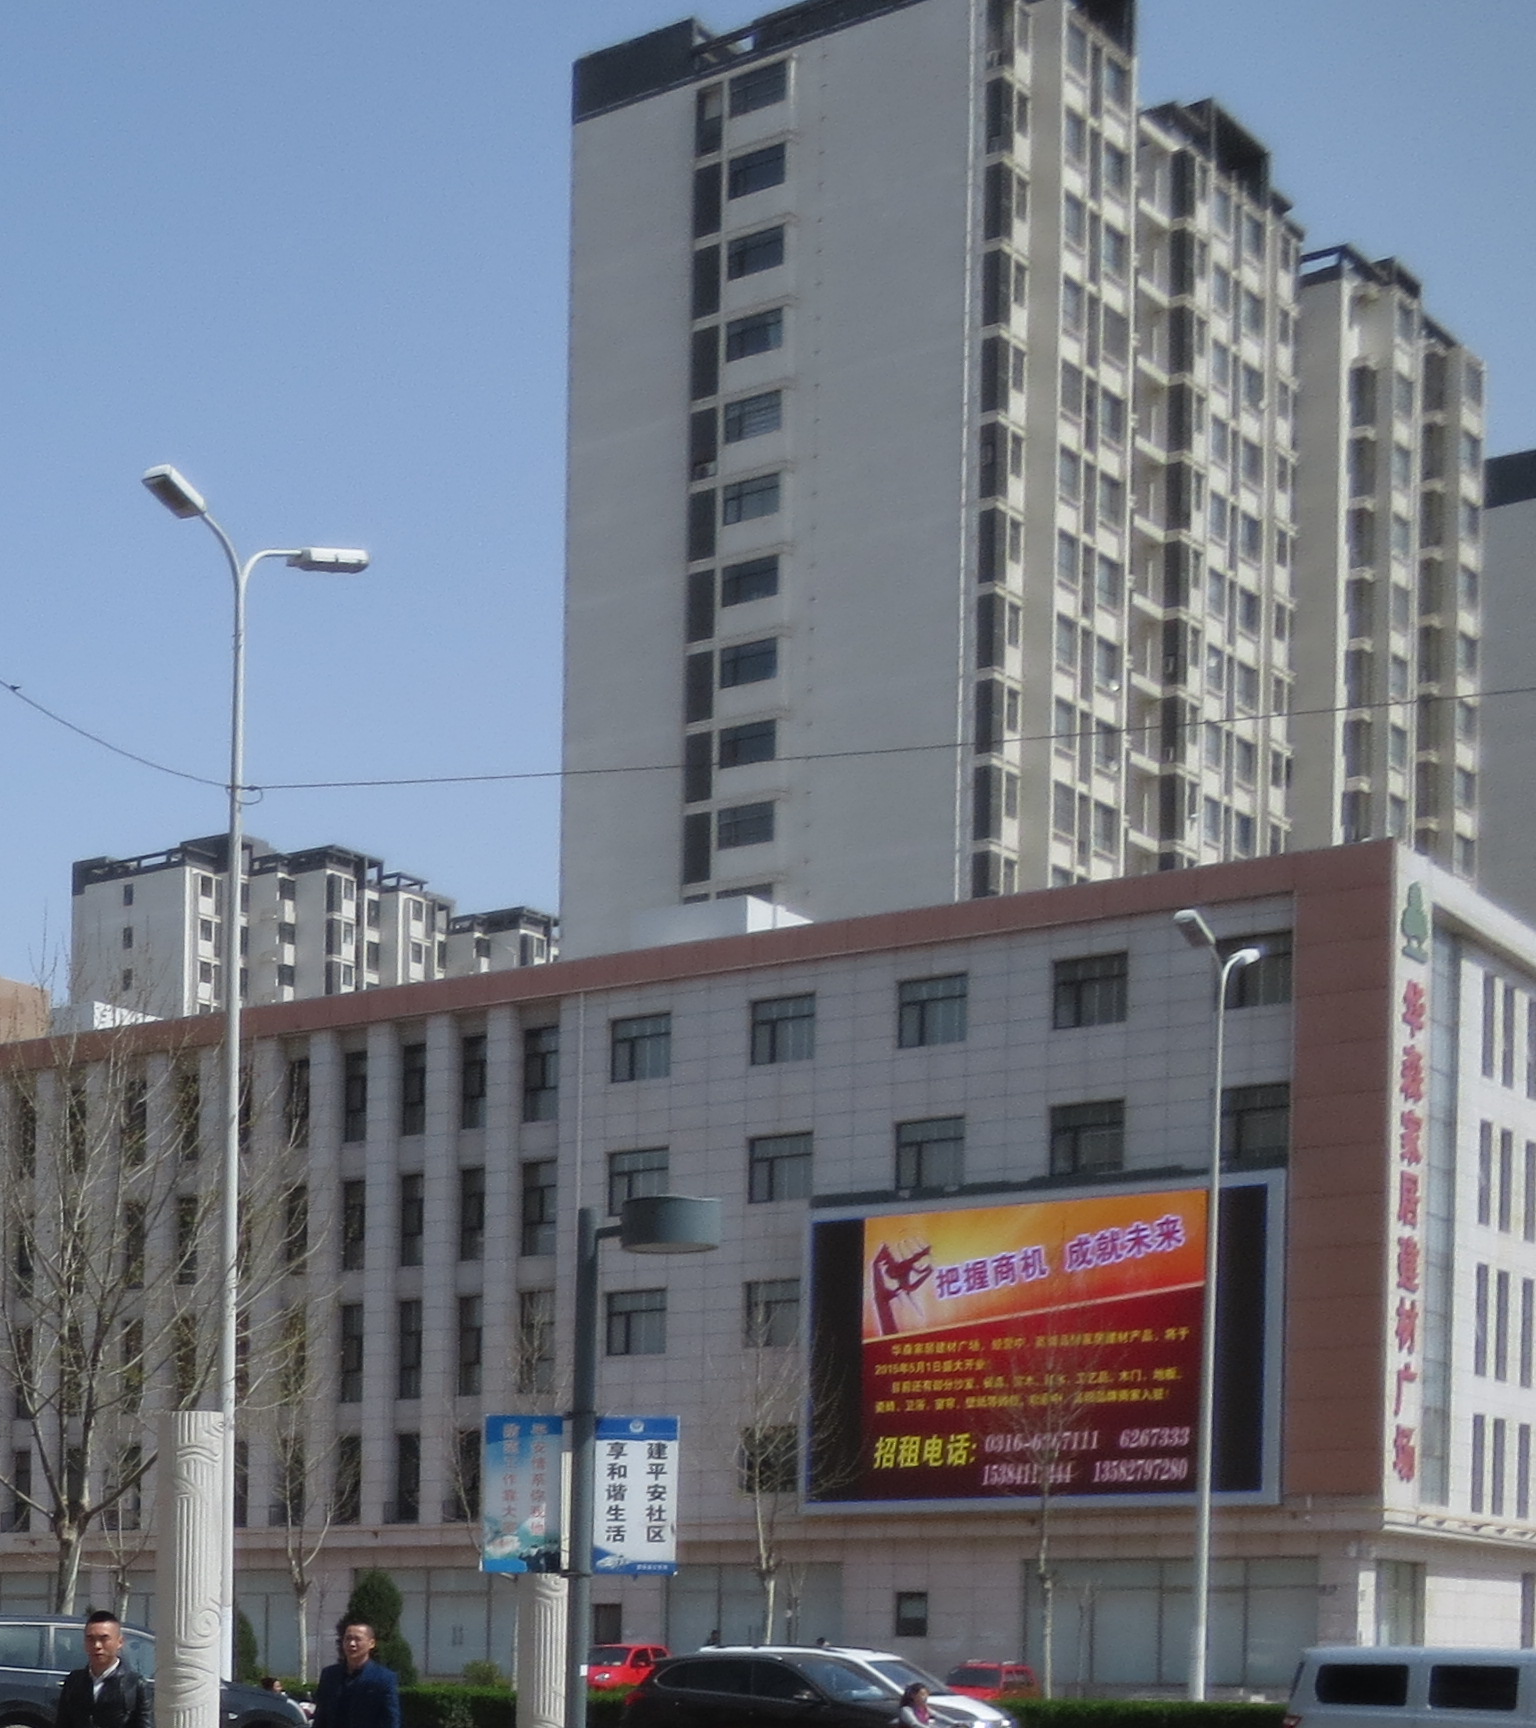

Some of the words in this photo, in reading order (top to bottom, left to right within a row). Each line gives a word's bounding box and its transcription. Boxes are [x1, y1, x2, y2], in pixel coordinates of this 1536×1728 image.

[934, 1246, 1049, 1300] 把握商机
[1064, 1213, 1186, 1272] 成就未来
[605, 1441, 628, 1543] 享和谐生活
[646, 1441, 669, 1543] 建平安社区
[981, 1461, 1073, 1487] 1538411444
